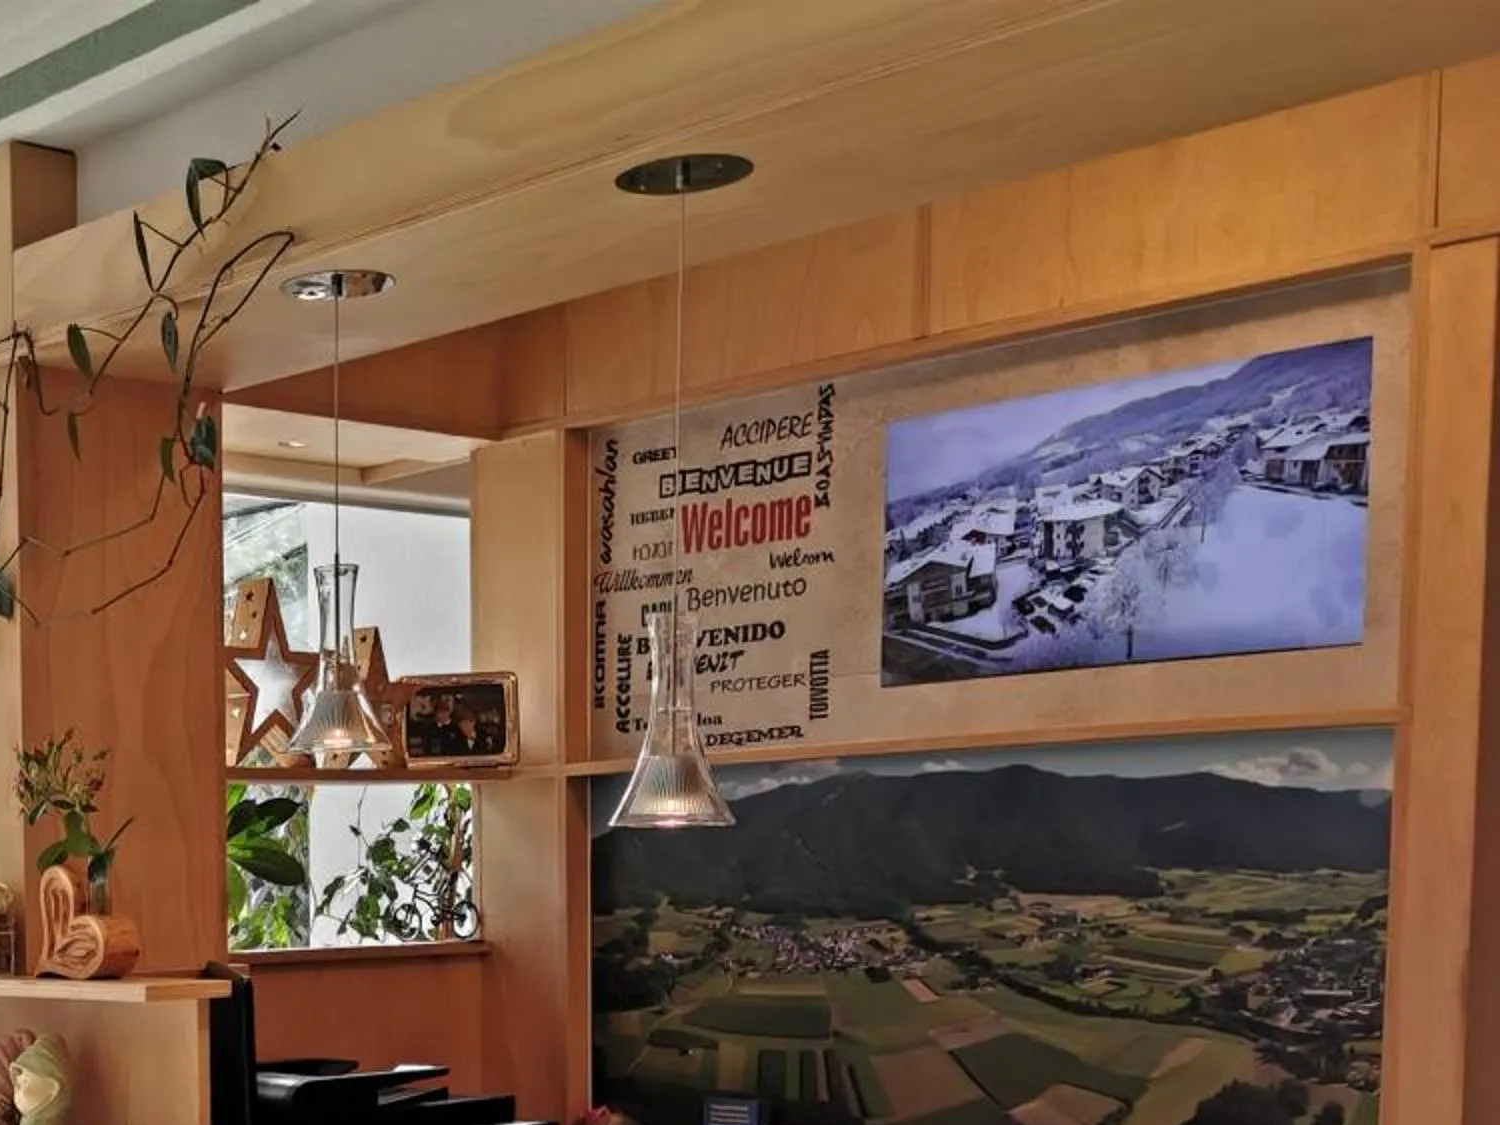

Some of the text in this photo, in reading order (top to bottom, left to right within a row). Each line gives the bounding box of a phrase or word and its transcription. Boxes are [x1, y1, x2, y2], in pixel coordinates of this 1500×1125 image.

[720, 413, 814, 448] ACCIPERE
[659, 451, 813, 499] BIENVENUE
[681, 494, 813, 554] Welcome
[594, 568, 694, 595] Willkommen
[686, 576, 807, 613] Benvenuto
[710, 673, 808, 693] PROTEGER
[706, 726, 805, 748] DEGEMER
